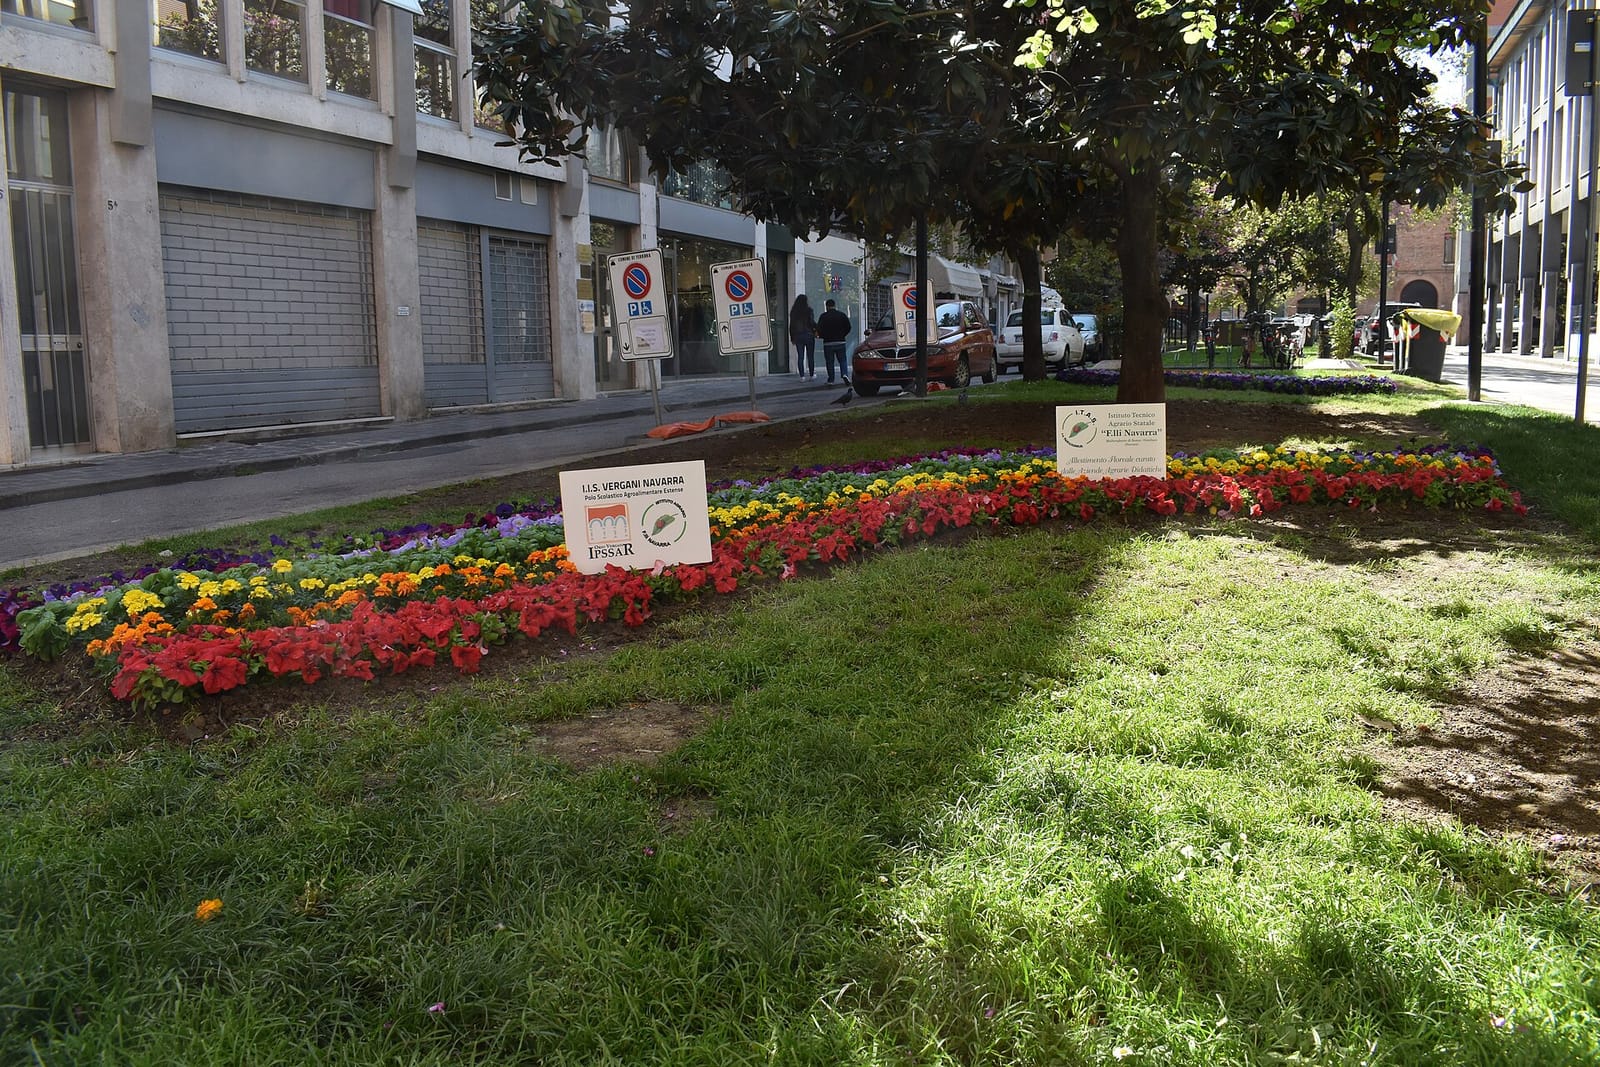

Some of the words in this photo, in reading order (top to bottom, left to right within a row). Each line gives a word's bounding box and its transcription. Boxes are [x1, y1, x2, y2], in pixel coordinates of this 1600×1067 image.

[630, 304, 637, 315] P
[731, 305, 737, 315] P
[582, 483, 600, 493] I.I.S.
[602, 479, 641, 491] VERGANI
[643, 476, 684, 487] NAVARRA
[597, 492, 623, 500] Scolastico
[624, 488, 662, 499] Agroalimentare
[588, 543, 635, 559] IPSSAR
